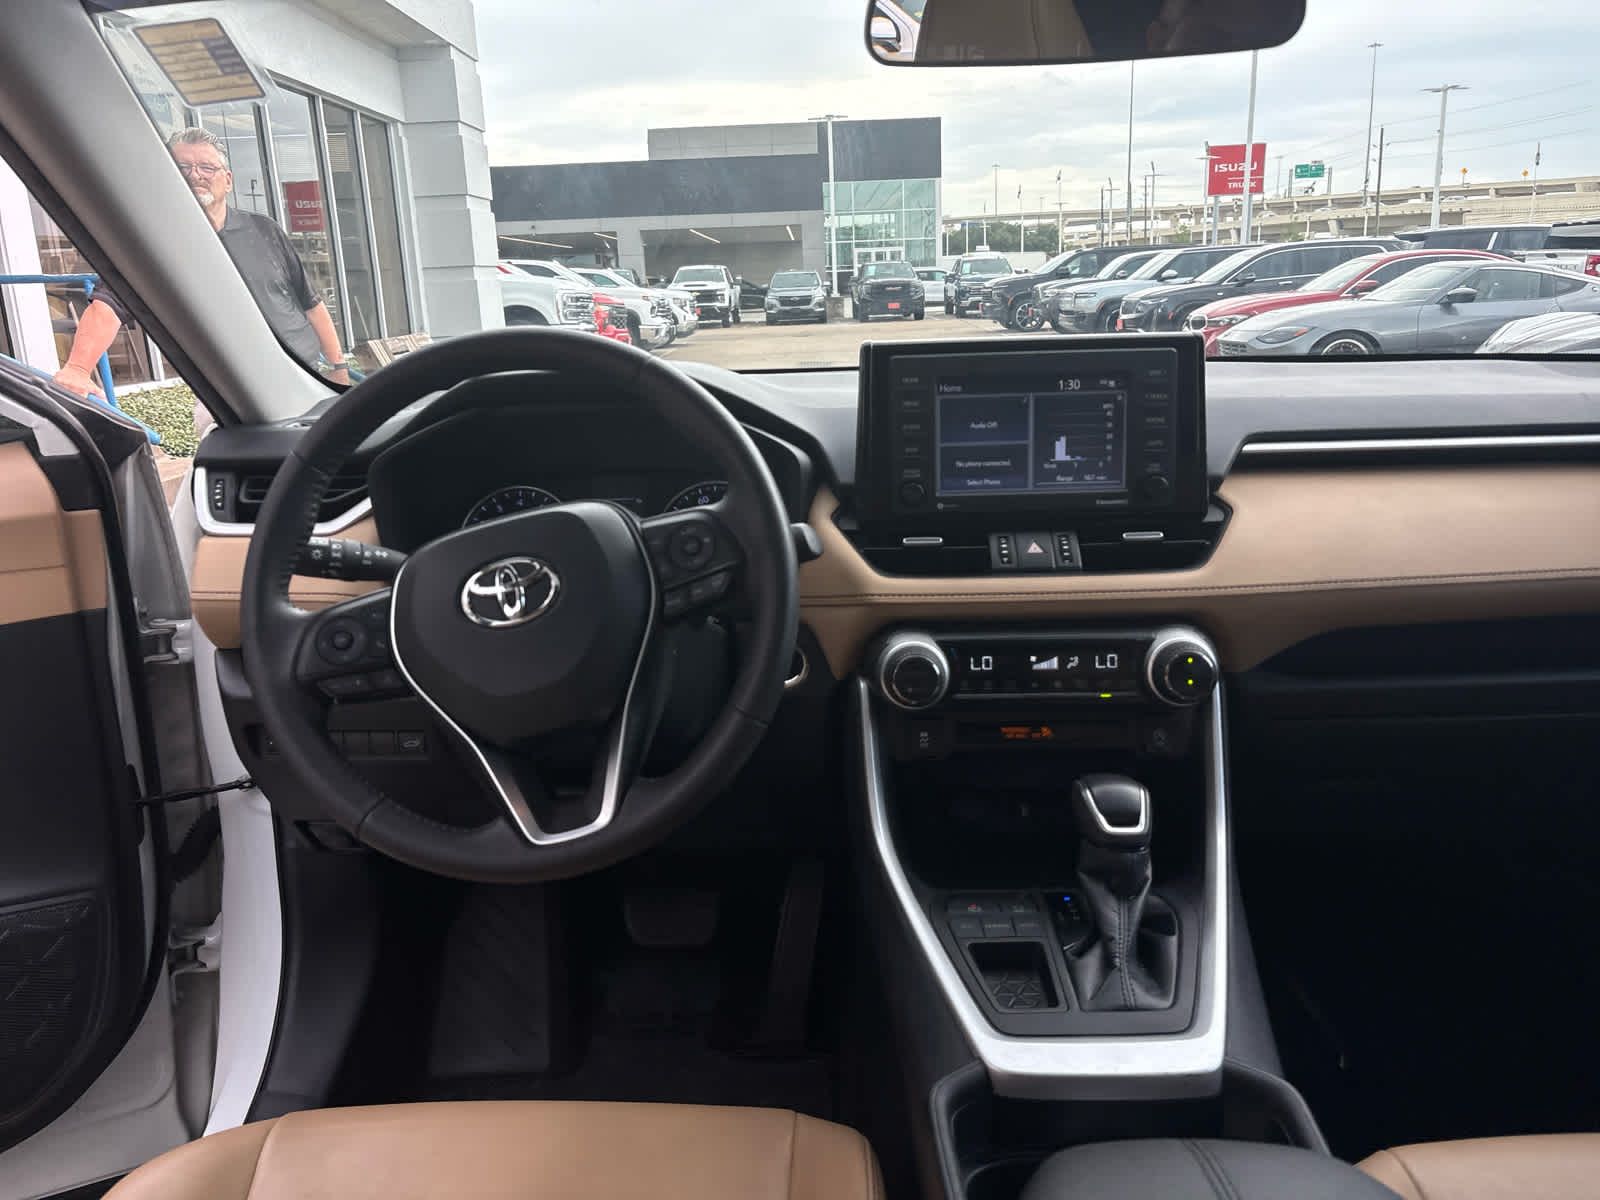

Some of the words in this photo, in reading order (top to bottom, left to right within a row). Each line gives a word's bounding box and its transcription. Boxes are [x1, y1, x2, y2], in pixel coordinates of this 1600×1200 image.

[1215, 161, 1257, 173] ISUZU
[1227, 181, 1257, 189] TRUK
[1059, 379, 1081, 390] 1:30
[697, 495, 709, 505] 60
[970, 655, 993, 671] LO
[1095, 653, 1118, 669] LO
